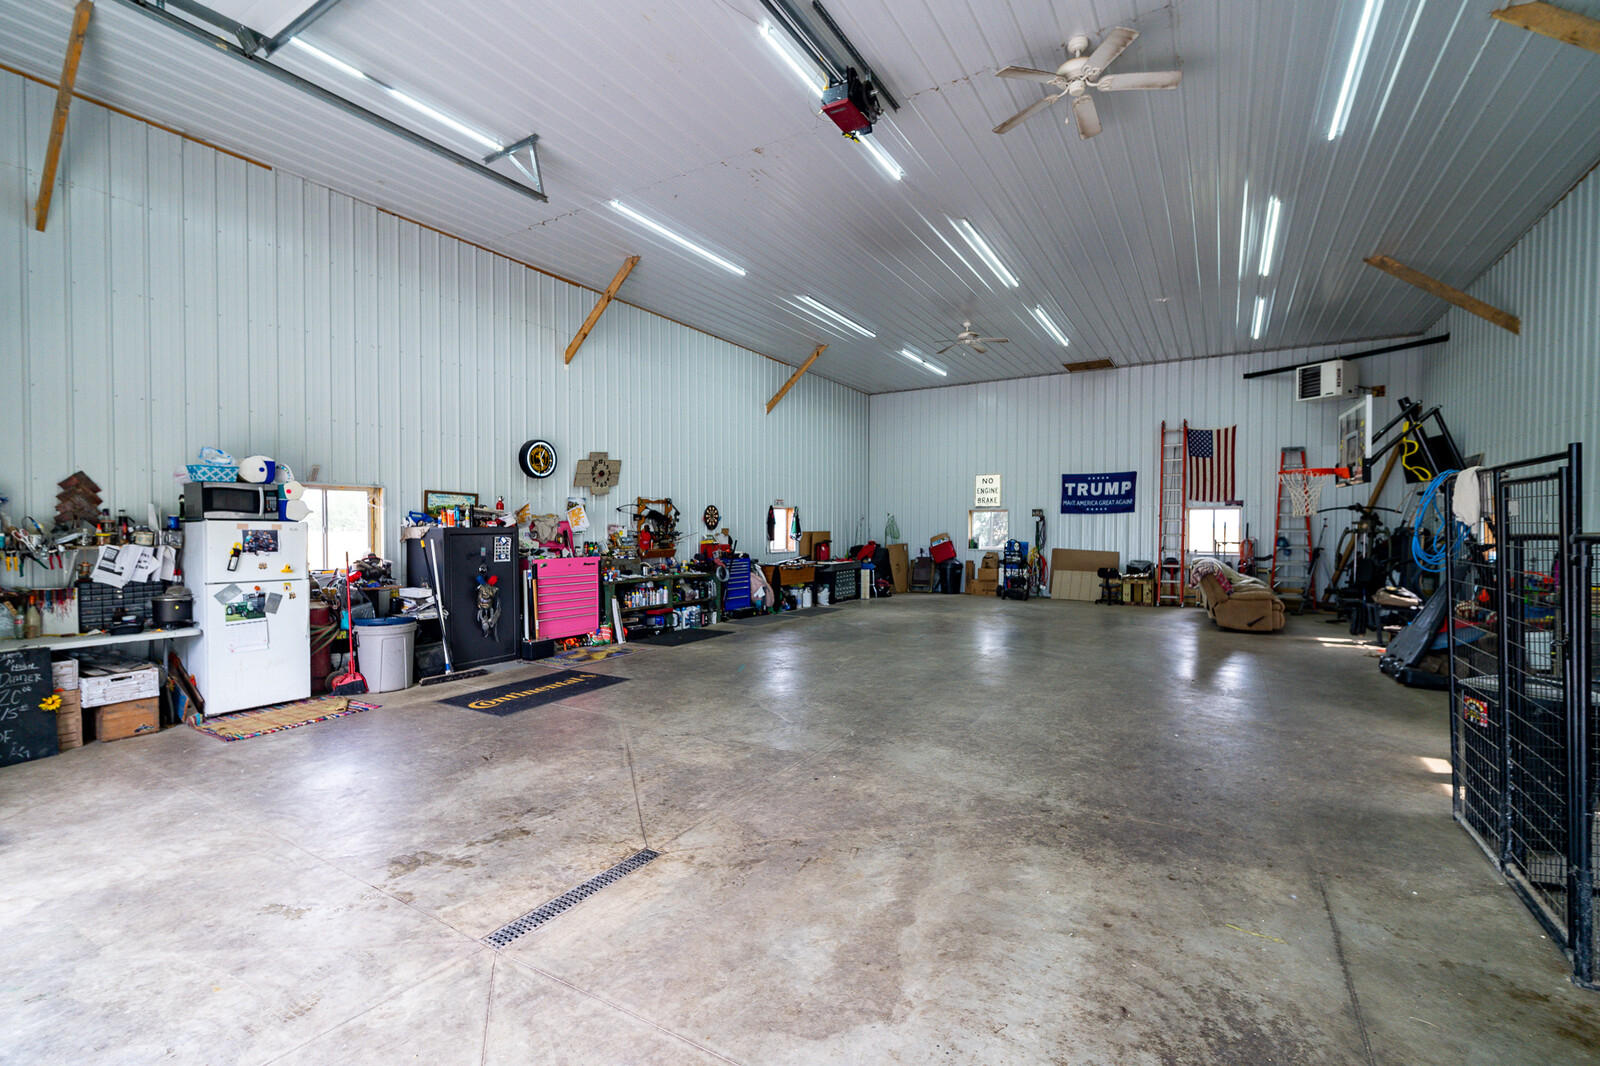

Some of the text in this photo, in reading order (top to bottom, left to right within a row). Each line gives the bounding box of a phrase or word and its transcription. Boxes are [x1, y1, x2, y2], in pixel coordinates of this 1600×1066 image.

[976, 487, 999, 495] ENGINE
[1064, 481, 1132, 496] TRUMP
[468, 676, 585, 709] Continental
